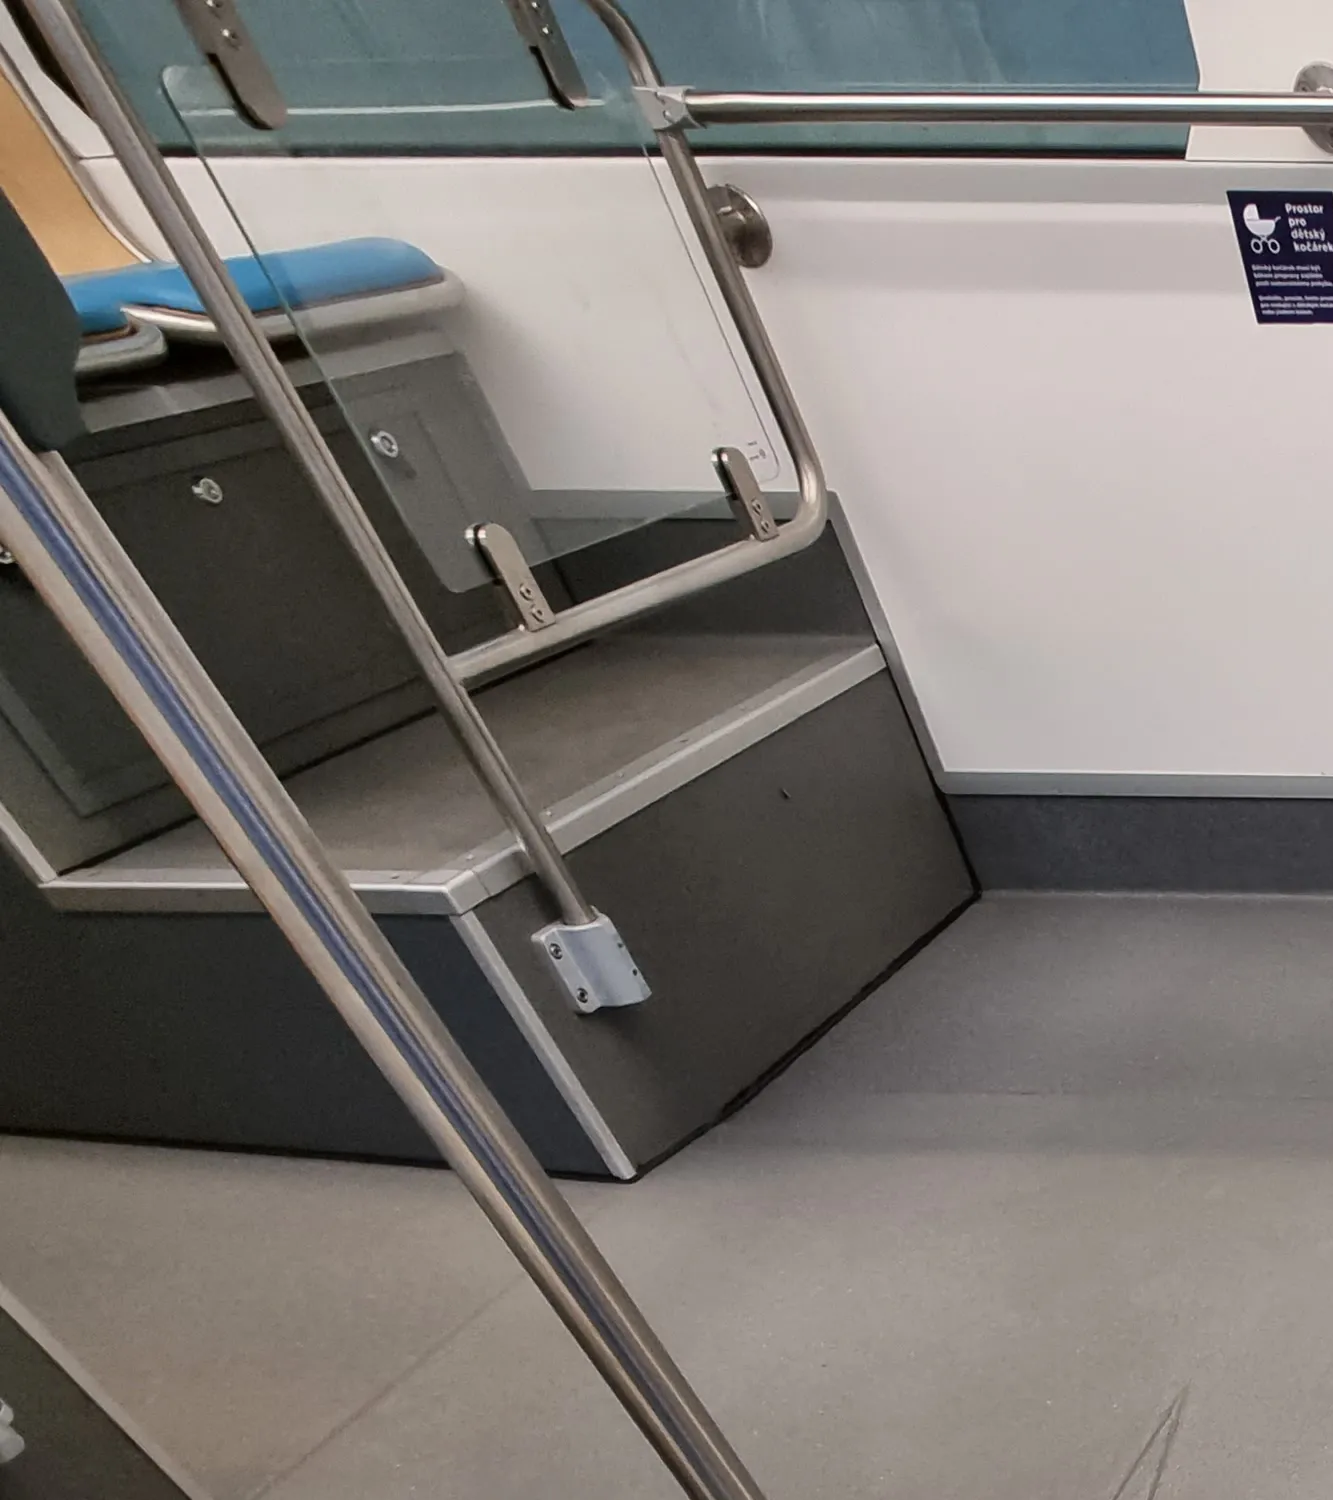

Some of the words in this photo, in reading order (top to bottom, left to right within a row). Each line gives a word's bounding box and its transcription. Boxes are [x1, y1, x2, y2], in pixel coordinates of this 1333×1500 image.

[1284, 203, 1324, 214] Prostor
[1288, 217, 1307, 228] pro
[1291, 228, 1326, 241] dětský
